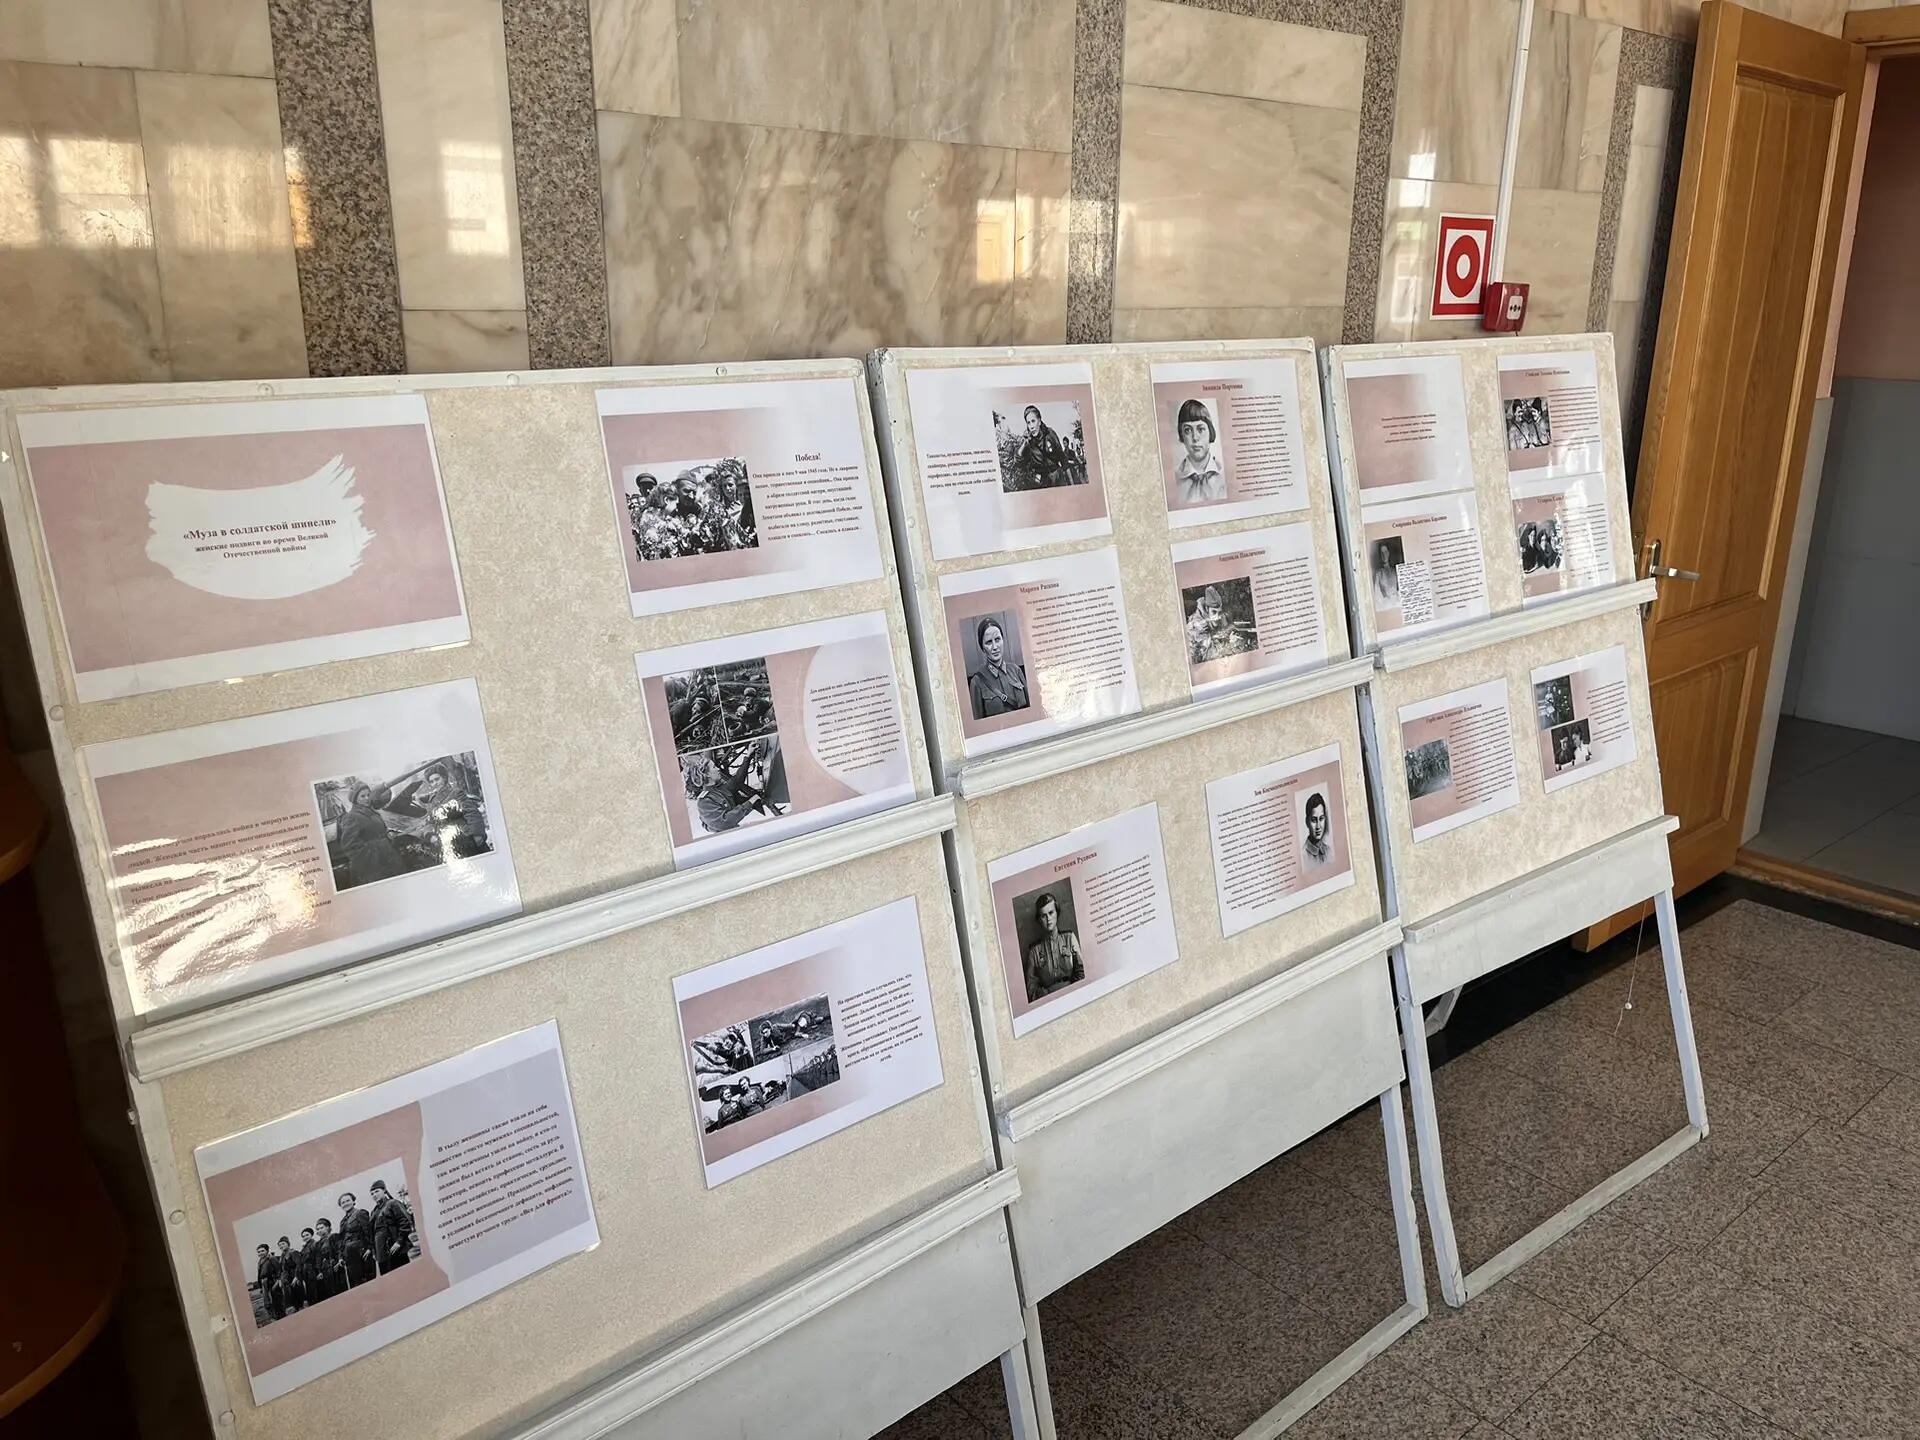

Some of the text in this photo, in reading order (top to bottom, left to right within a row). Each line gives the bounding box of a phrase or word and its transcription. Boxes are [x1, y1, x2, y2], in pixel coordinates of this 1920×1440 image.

[795, 452, 820, 462] Победа!
[182, 529, 218, 540] «Муза
[229, 520, 288, 535] солдатской
[290, 519, 336, 528] шинели»
[195, 543, 227, 552] женские
[228, 540, 261, 548] подвиги
[296, 531, 328, 541] Великой
[222, 546, 281, 559] Отечественной
